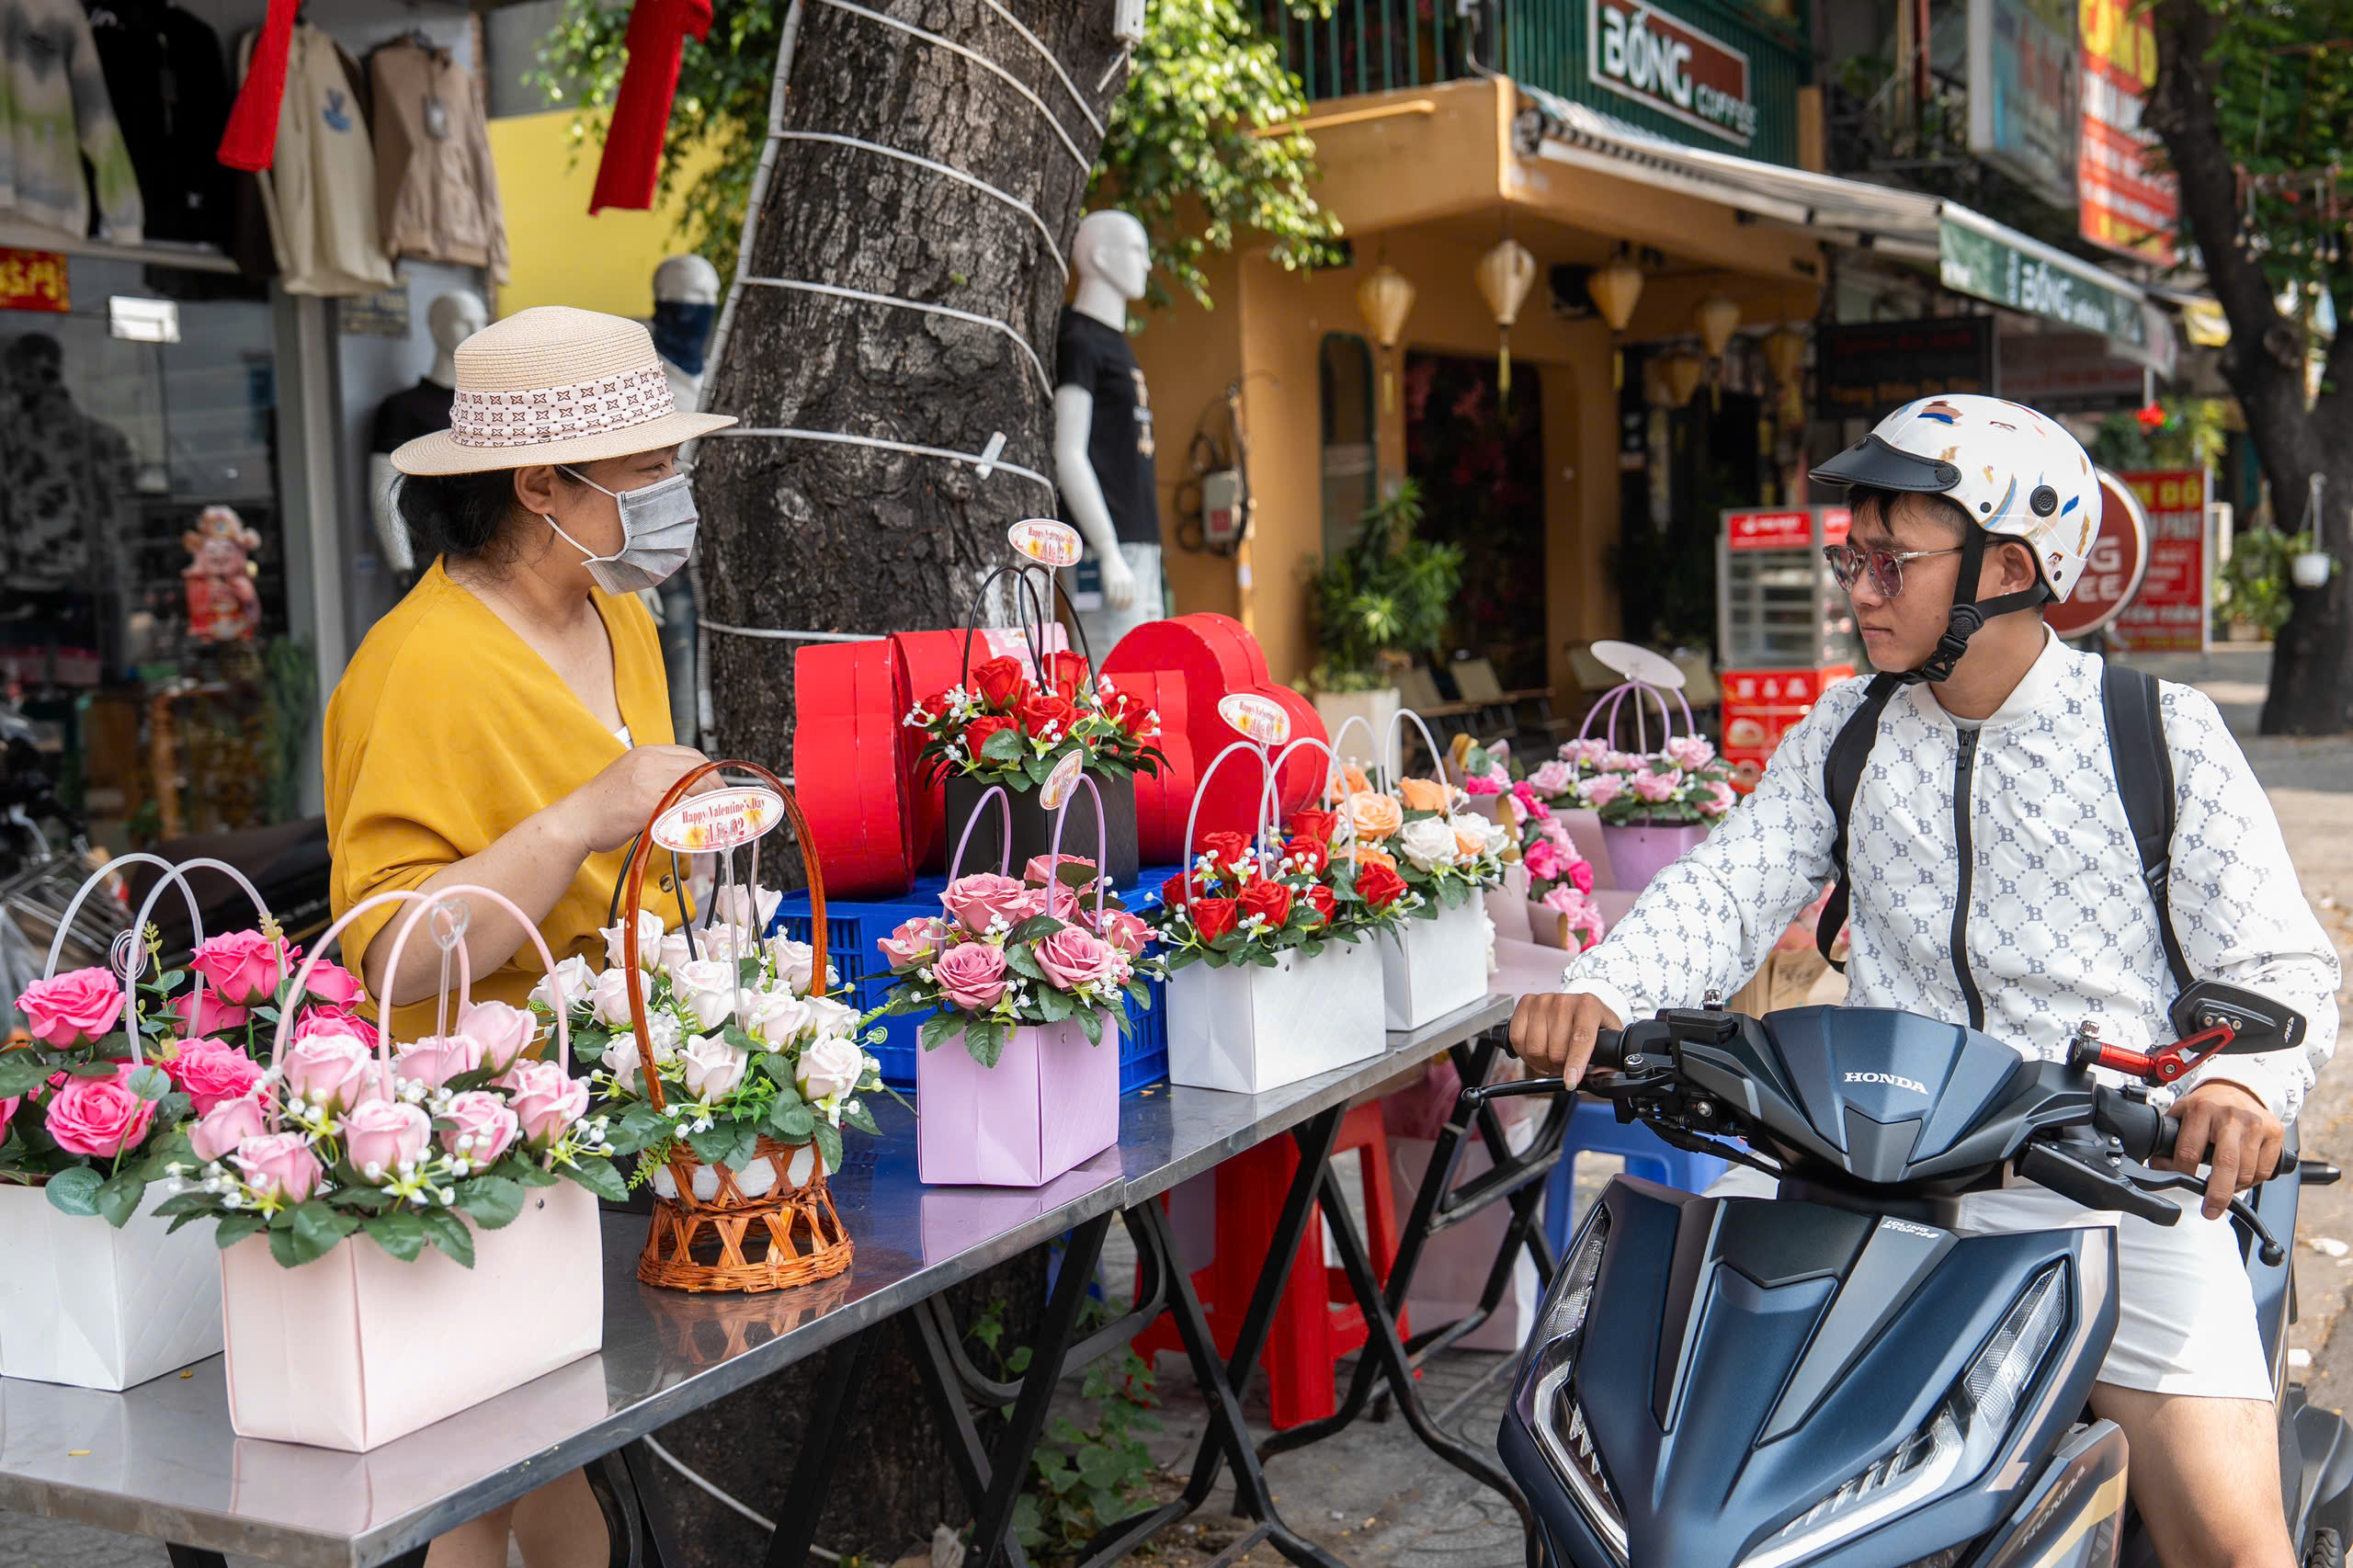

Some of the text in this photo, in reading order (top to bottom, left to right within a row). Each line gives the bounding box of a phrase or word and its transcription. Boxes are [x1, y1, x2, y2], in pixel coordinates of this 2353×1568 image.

[682, 811, 706, 824] Happy
[752, 798, 765, 811] Day
[1845, 1072, 1929, 1096] HONDA
